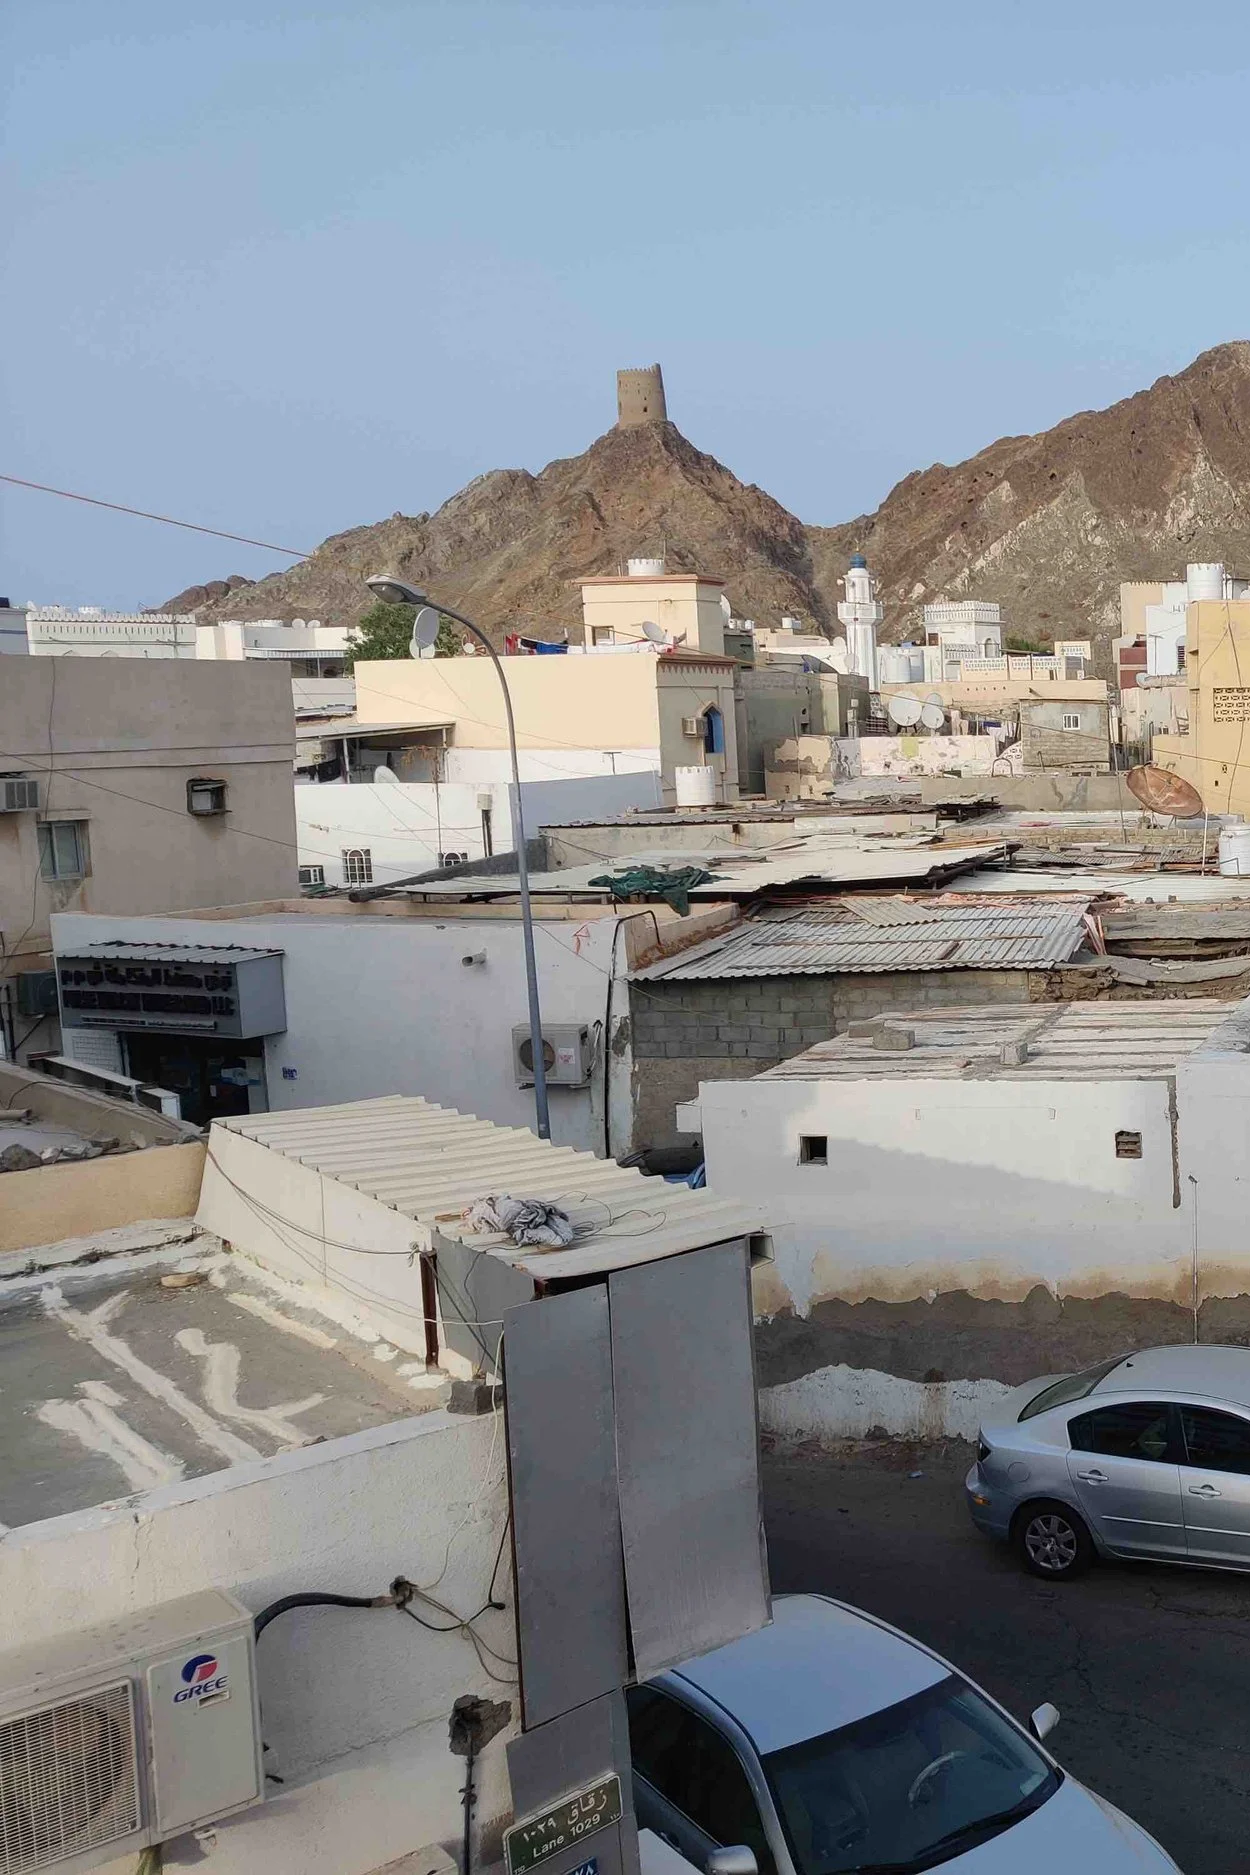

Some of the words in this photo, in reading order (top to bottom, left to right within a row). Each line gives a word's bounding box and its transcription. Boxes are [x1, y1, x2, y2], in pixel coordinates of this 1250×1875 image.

[173, 1675, 229, 1703] GREE
[567, 1789, 608, 1825] زقاق
[533, 1835, 565, 1858] Lane
[569, 1813, 601, 1837] 1029
